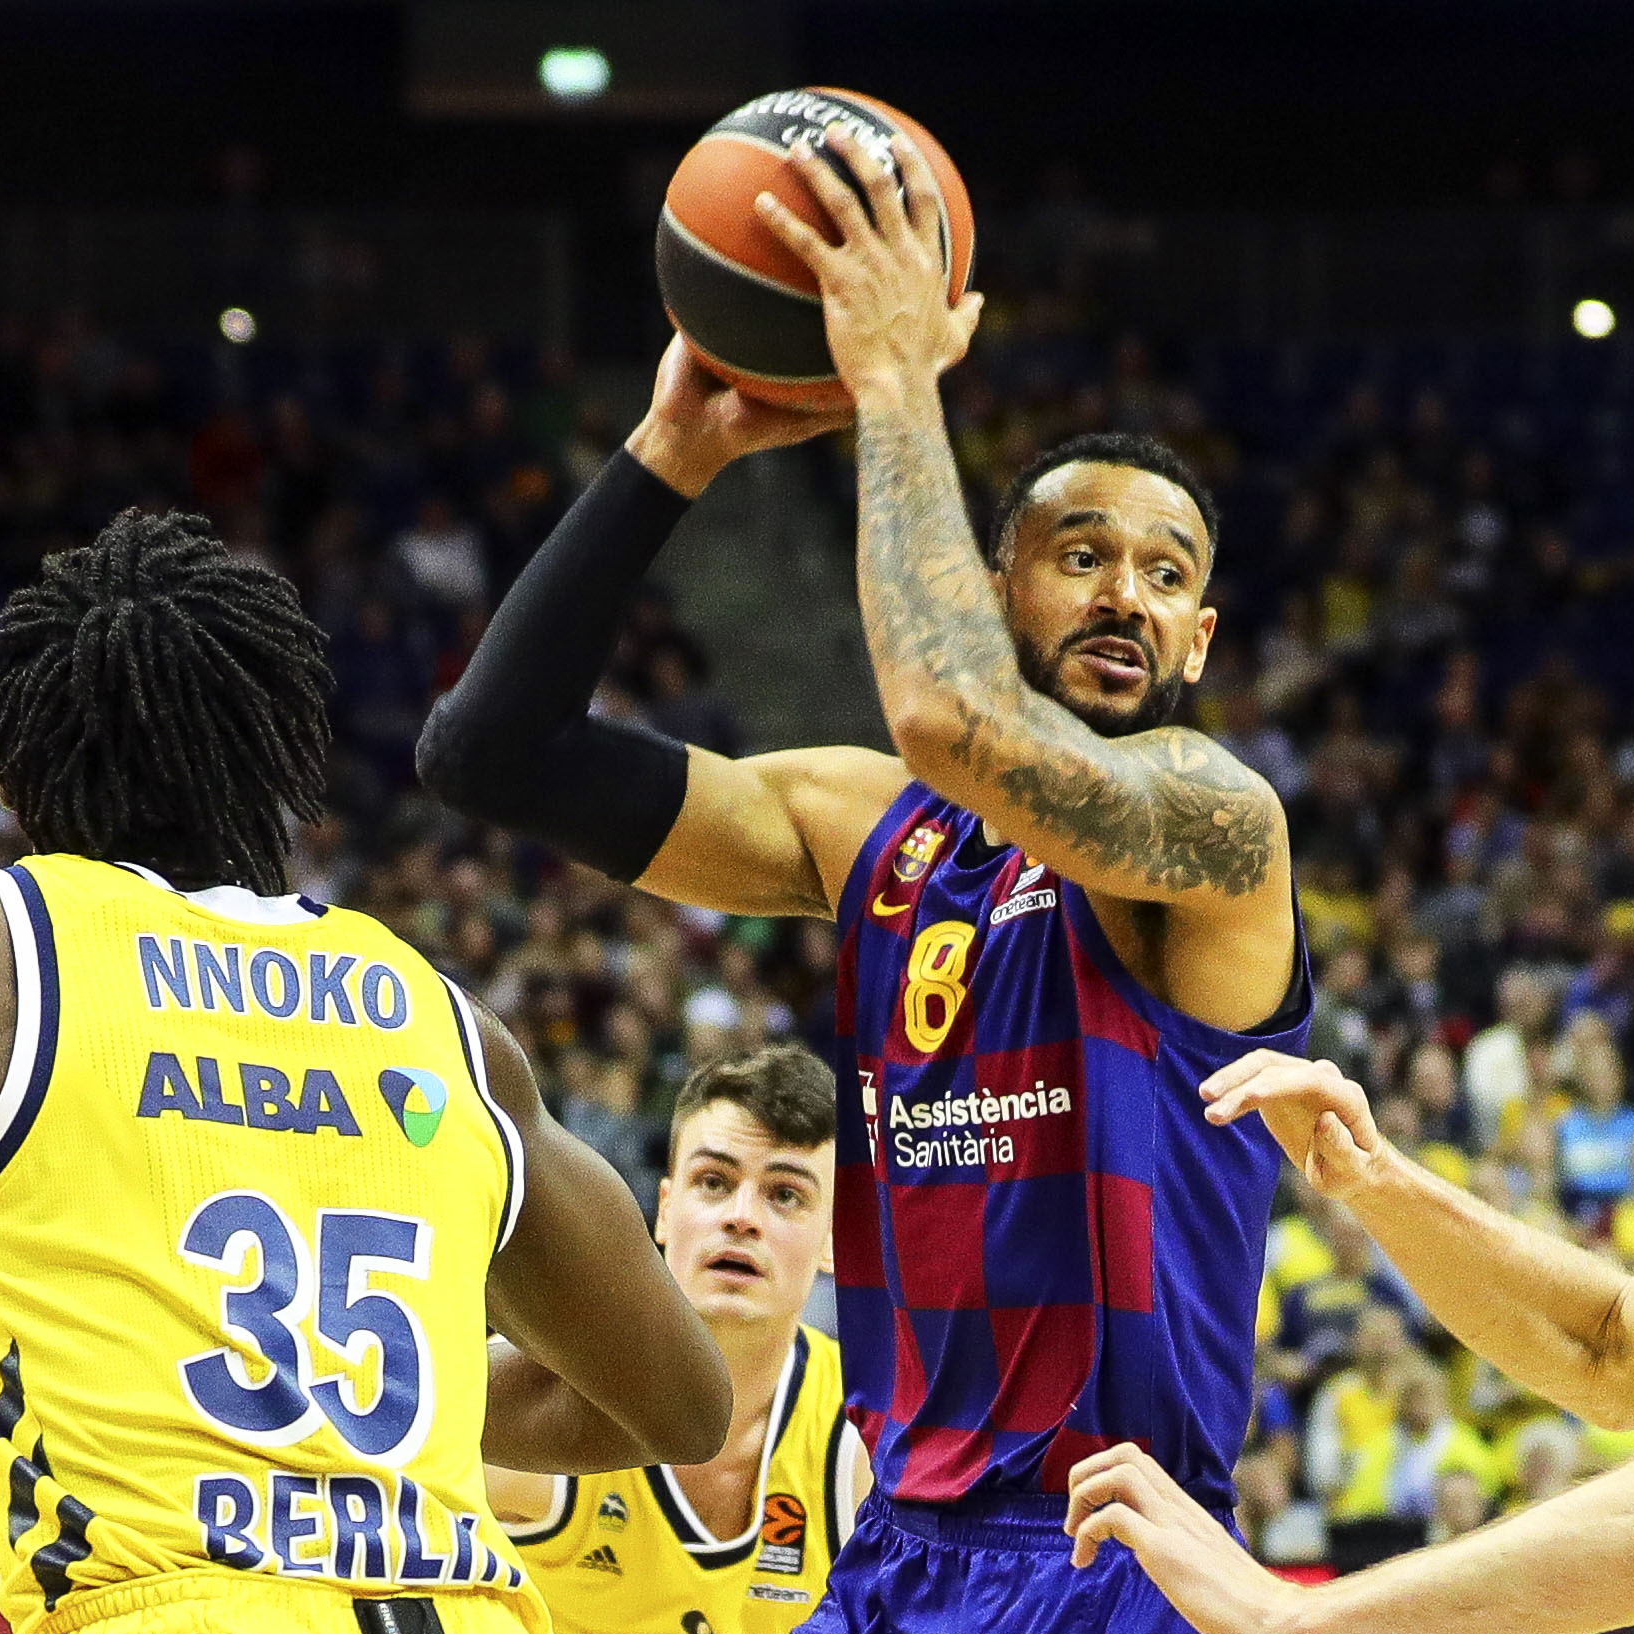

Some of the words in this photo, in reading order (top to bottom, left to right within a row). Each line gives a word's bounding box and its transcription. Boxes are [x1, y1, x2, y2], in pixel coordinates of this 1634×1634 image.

[136, 932, 410, 1031] NNOKO
[903, 920, 977, 1053] 8
[136, 1051, 363, 1138] ALBA
[888, 1080, 1072, 1130] Assistència
[893, 1130, 1015, 1168] Sanitària
[178, 1190, 434, 1468] 35
